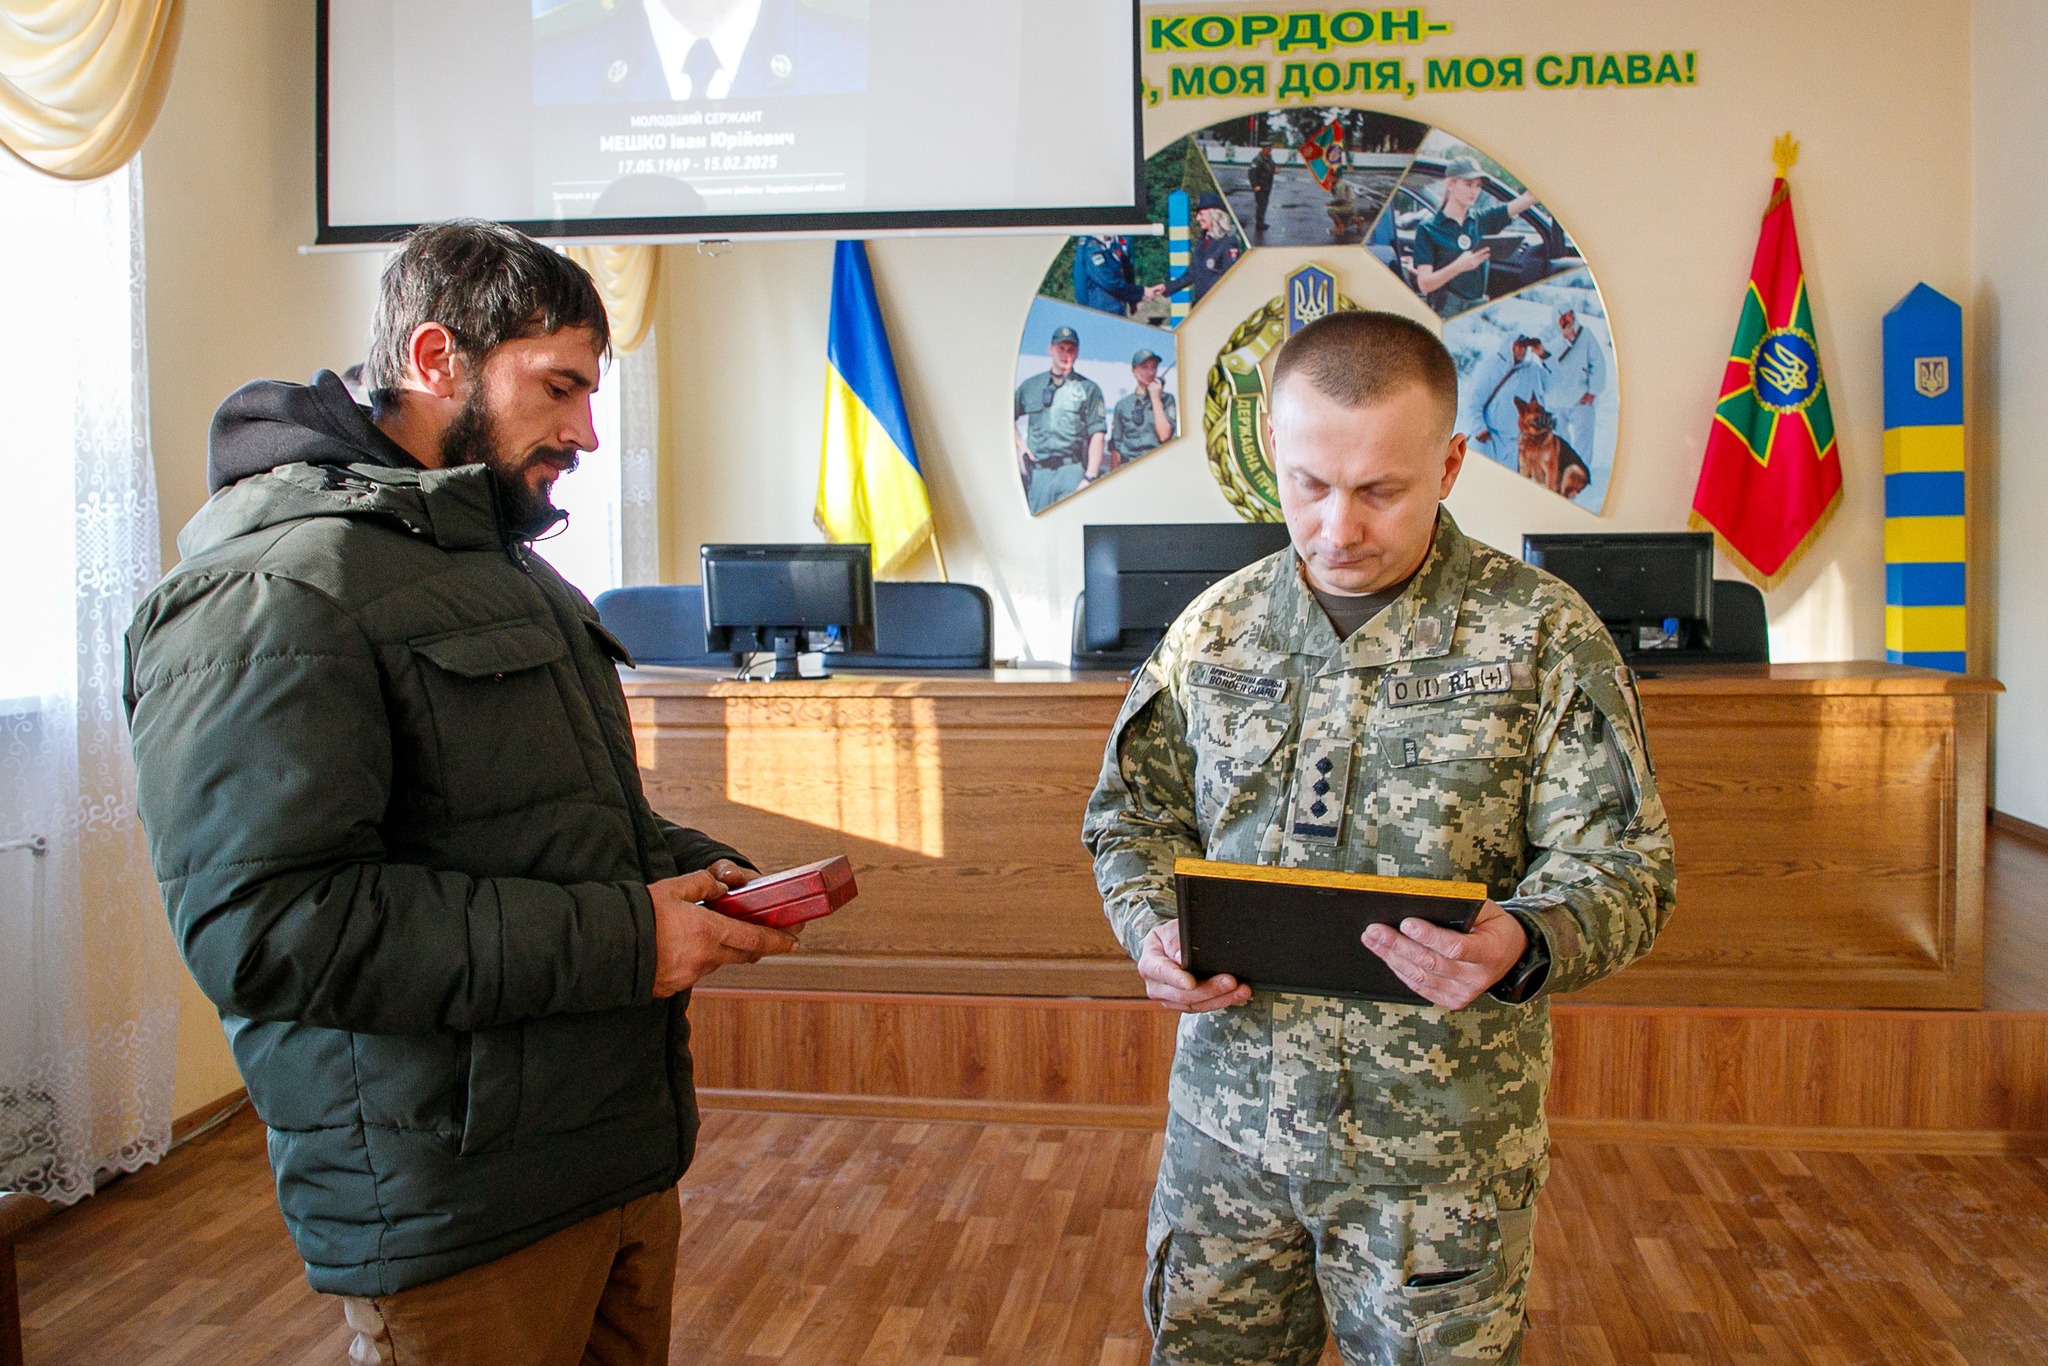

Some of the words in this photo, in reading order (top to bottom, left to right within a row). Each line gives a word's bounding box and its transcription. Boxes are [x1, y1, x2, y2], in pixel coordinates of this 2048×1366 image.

[1150, 9, 1447, 51] КОРДОН-
[1172, 65, 1264, 96] МОЯ
[1278, 61, 1415, 99] ДОЛЯ,
[1428, 57, 1523, 88] МОЯ
[1536, 53, 1695, 88] СЛАВА!
[630, 110, 703, 128] МОЛОДШИЙ
[704, 110, 764, 125] СЕРЖАНТ
[600, 133, 667, 152] МЕШКО
[670, 133, 707, 150] Іван
[710, 130, 796, 151] Юрійович
[617, 157, 691, 174] 17.05.1969
[703, 154, 779, 171] 15.02.2025
[1237, 398, 1261, 473] ДЕРЖАВНА
[1209, 675, 1247, 693] BORDER
[1247, 686, 1278, 698] GUARD
[1448, 671, 1474, 693] Rh
[1480, 667, 1502, 687] (+)
